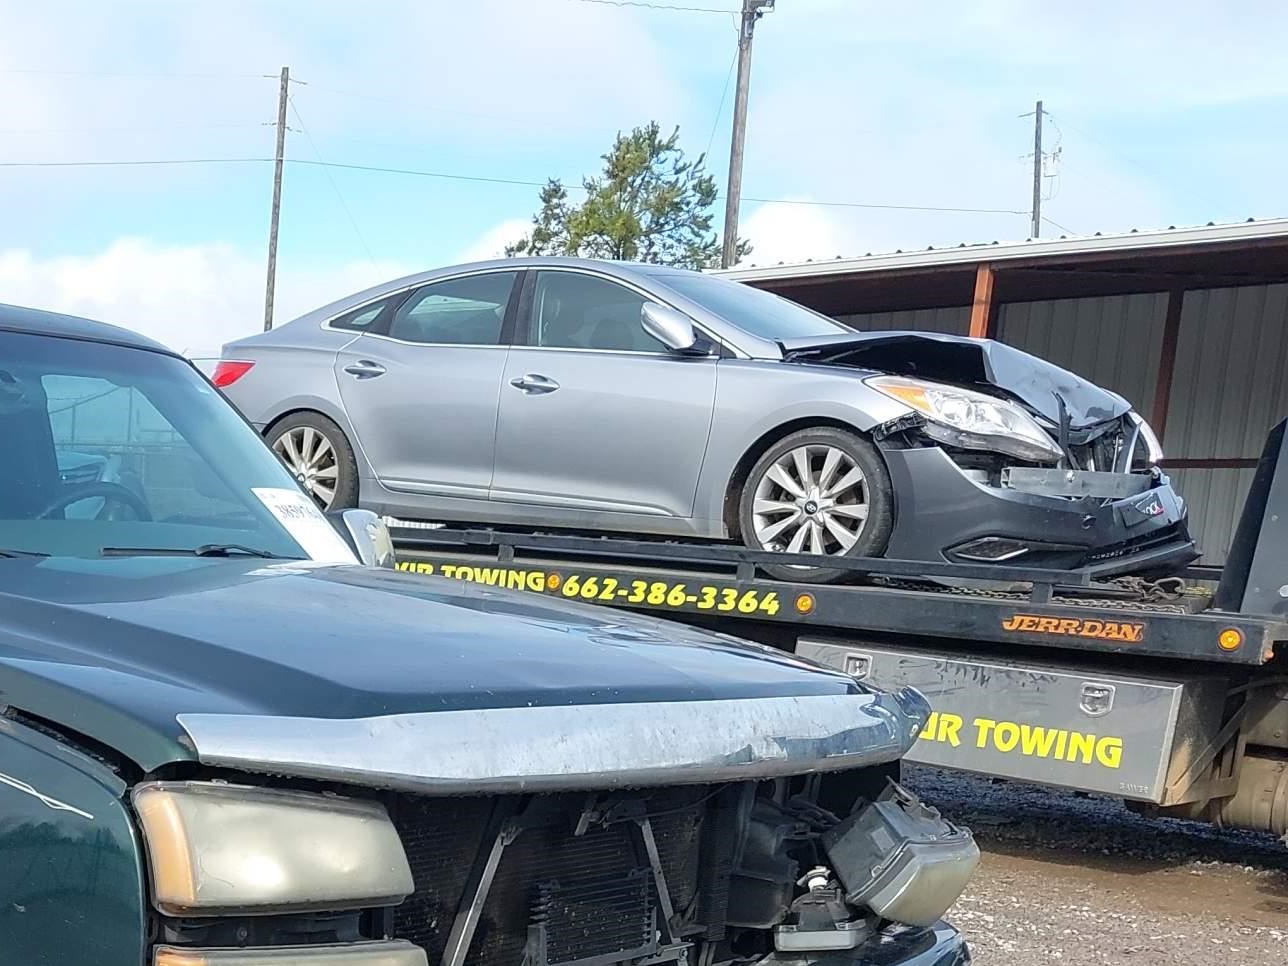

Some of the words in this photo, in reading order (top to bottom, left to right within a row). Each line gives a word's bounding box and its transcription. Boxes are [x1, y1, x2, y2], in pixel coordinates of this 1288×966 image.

[440, 564, 546, 592] TOWING
[562, 575, 780, 615] 662-386-3364
[973, 718, 1123, 768] TOWING
